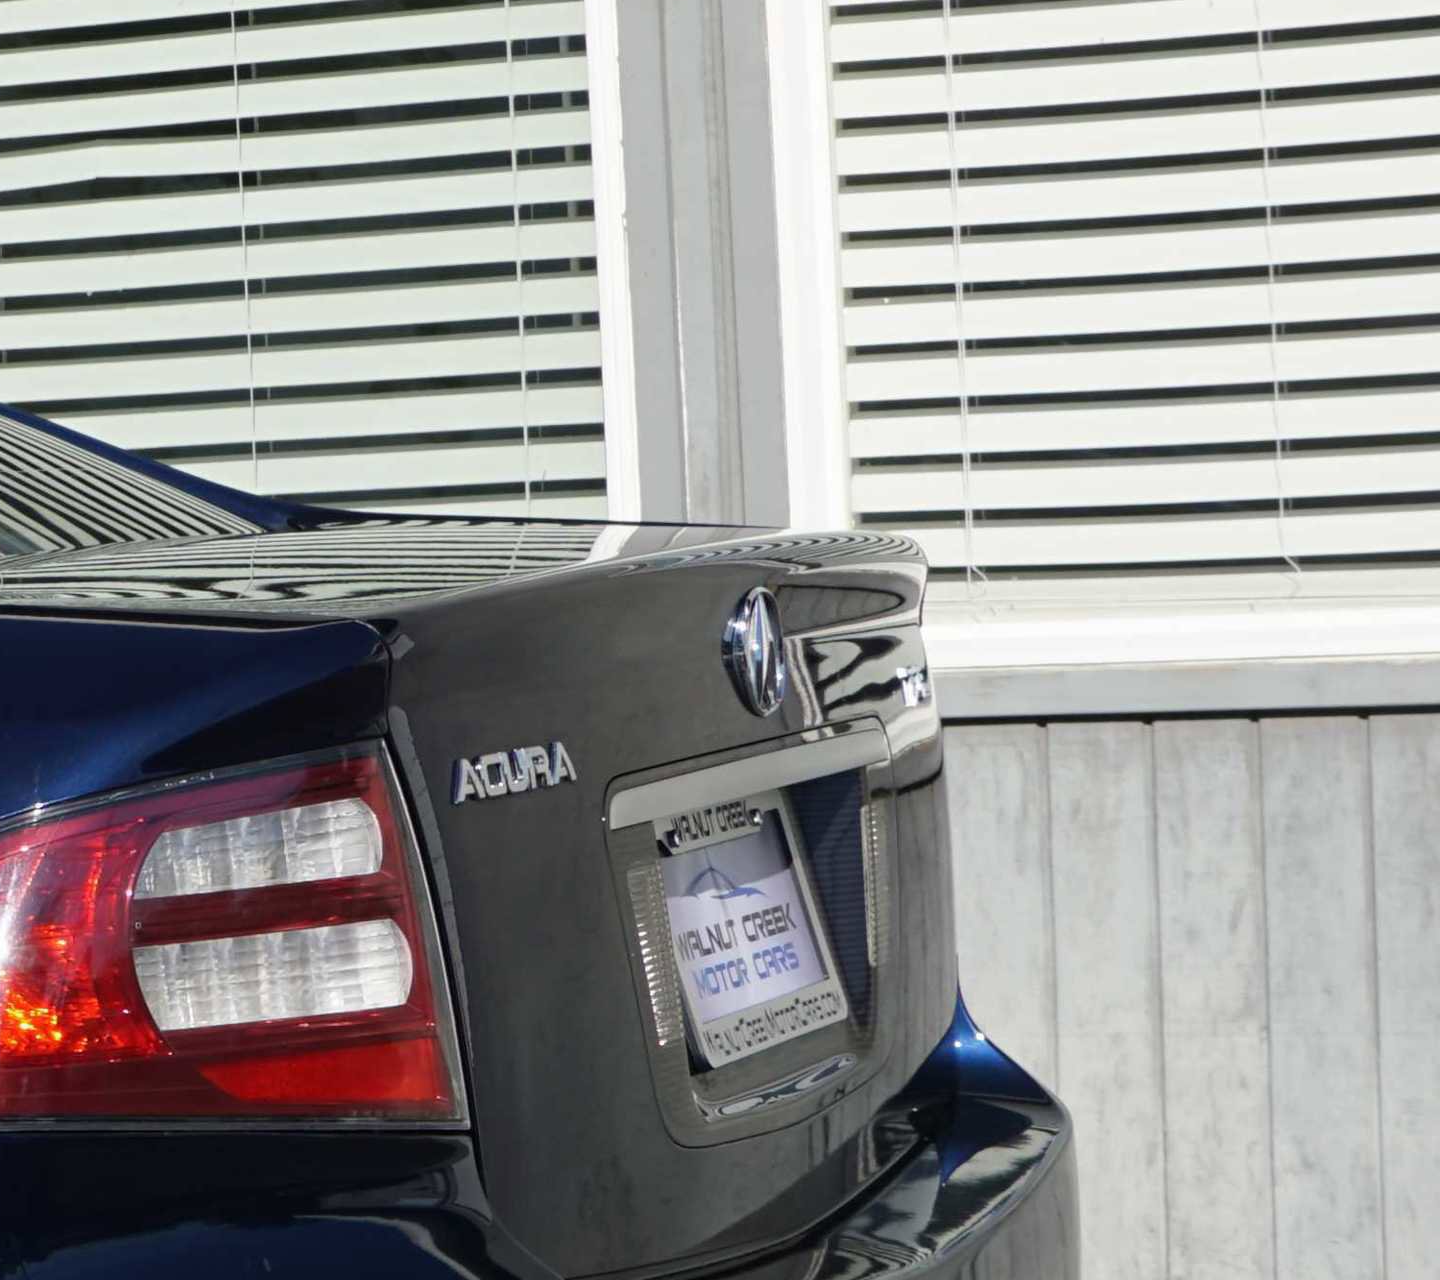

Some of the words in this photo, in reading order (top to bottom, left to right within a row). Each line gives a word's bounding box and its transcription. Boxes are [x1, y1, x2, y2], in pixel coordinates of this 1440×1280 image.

[451, 740, 578, 804] ACURA
[677, 918, 735, 962] WALNUT
[742, 902, 798, 943] CREEK
[692, 957, 750, 1000] MOTOR
[752, 942, 801, 980] CARS
